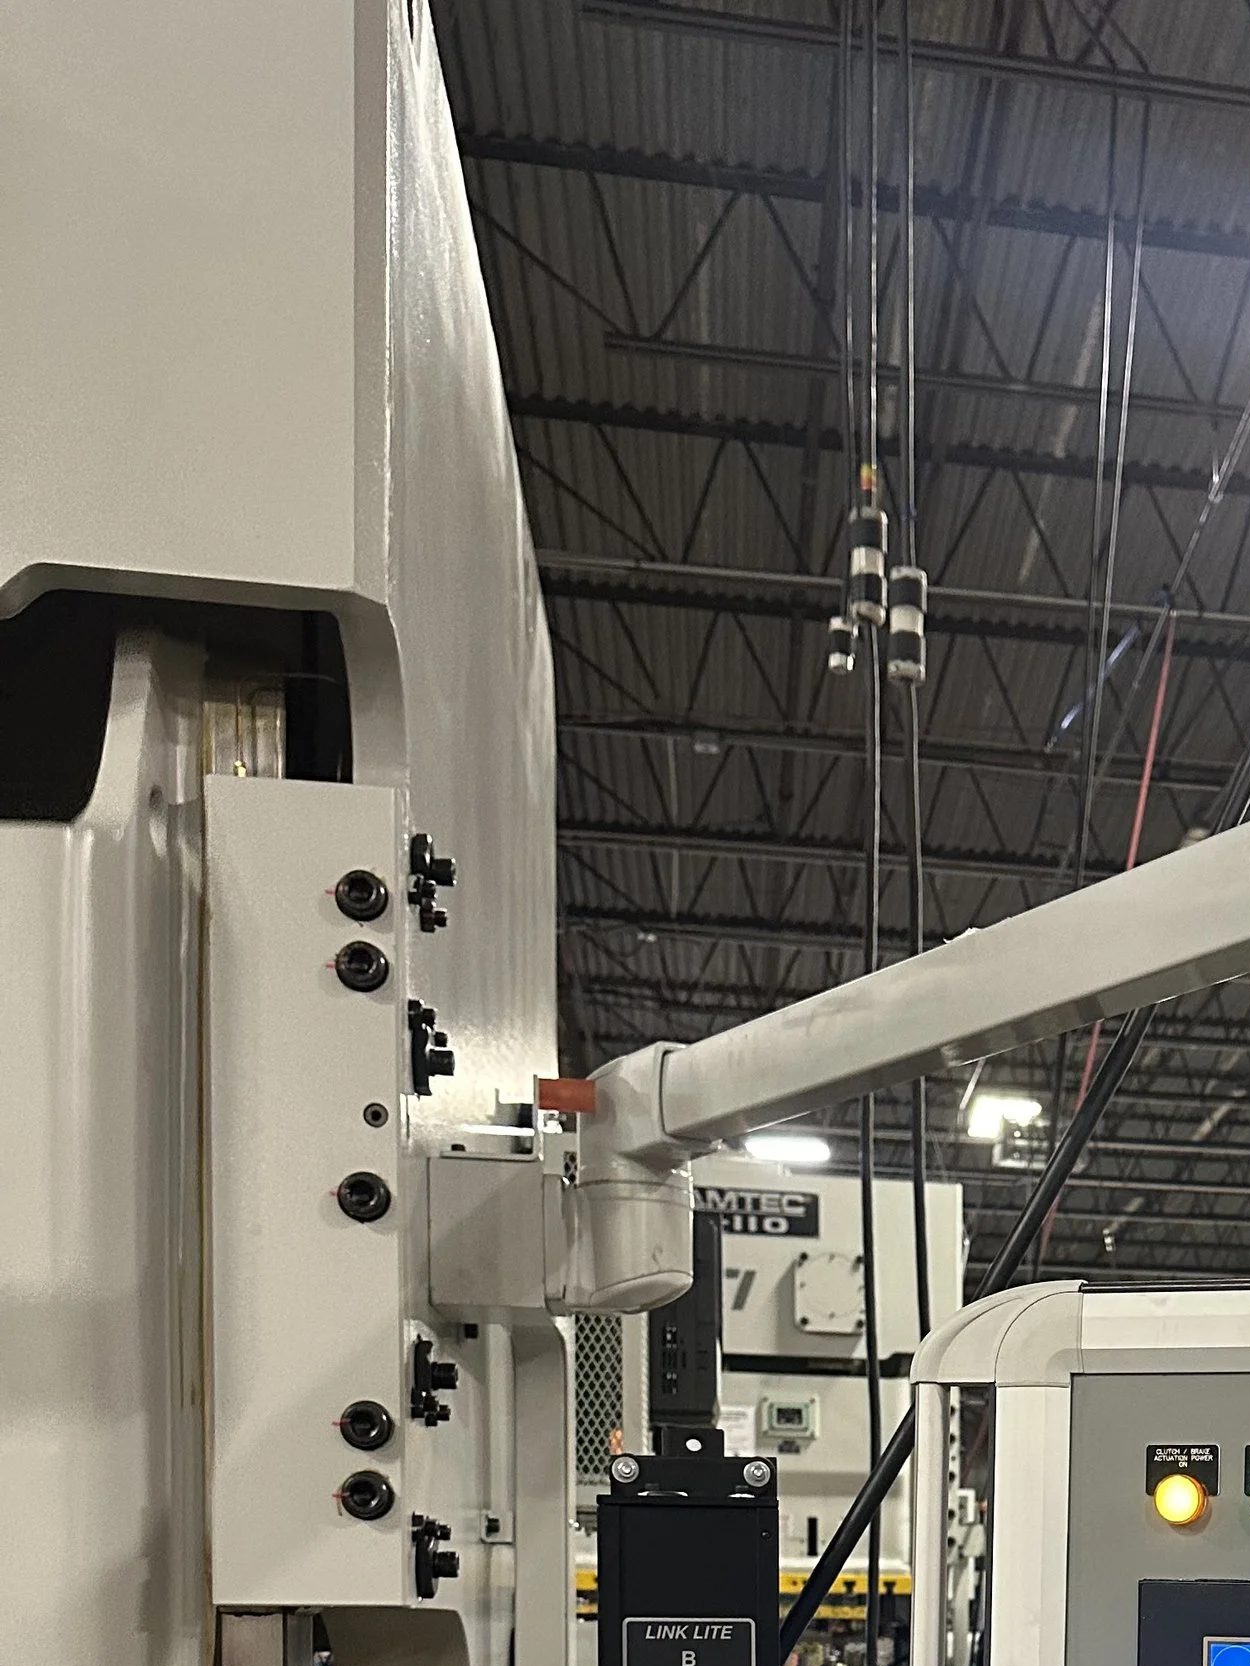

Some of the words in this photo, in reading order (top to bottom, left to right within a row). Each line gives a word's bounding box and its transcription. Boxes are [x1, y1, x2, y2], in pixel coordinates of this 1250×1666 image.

[726, 1267, 756, 1310] 7
[645, 1625, 688, 1640] LINK
[693, 1625, 733, 1640] LITE
